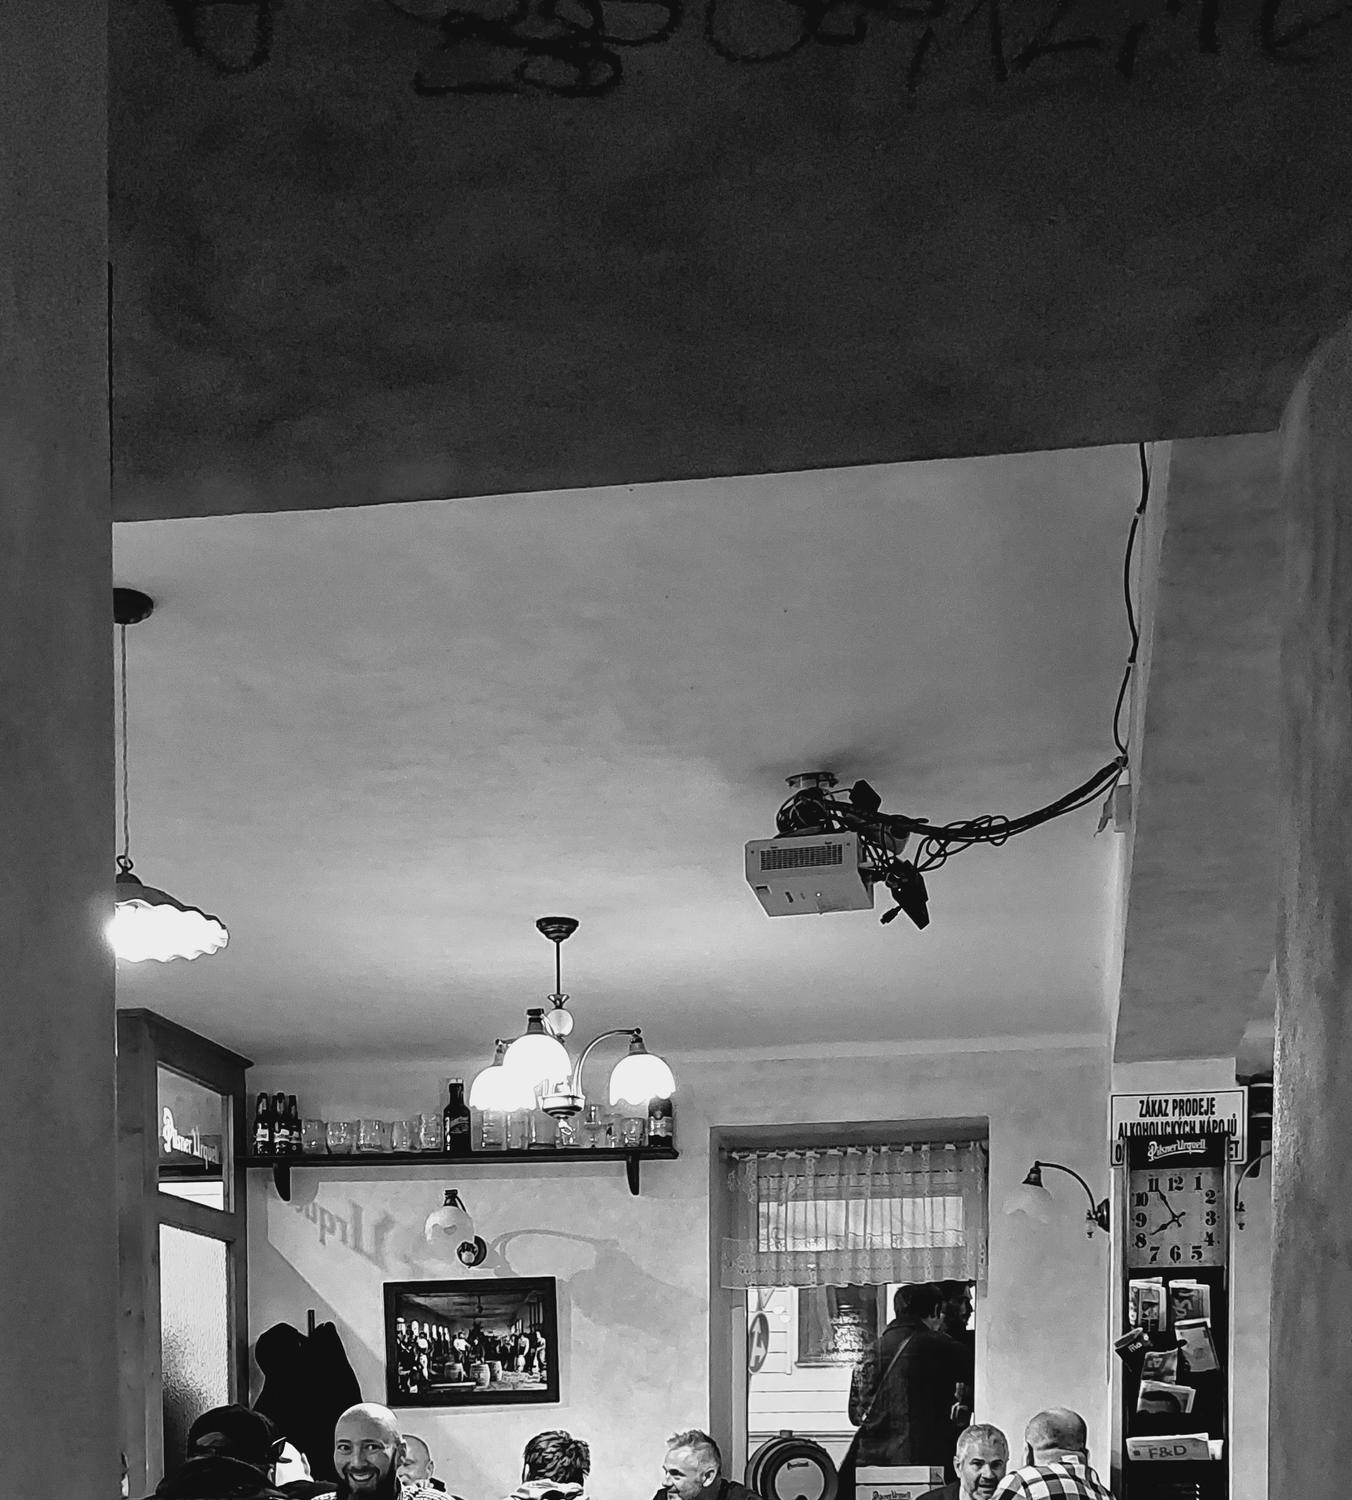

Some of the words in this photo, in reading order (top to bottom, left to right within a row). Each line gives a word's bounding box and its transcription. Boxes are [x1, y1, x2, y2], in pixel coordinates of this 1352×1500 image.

[1139, 1096, 1169, 1118] ZÁKAZ
[1172, 1097, 1216, 1117] PRODEJE
[1148, 1178, 1159, 1192] 11
[1168, 1176, 1184, 1191] 12
[1194, 1175, 1203, 1190] 1
[1135, 1192, 1148, 1207] 10
[1205, 1190, 1216, 1204] 2
[1135, 1212, 1147, 1228] 9
[1205, 1210, 1217, 1226] 3
[1135, 1233, 1147, 1248] 8
[1204, 1231, 1215, 1246] 4
[1149, 1246, 1160, 1264] 7
[1169, 1245, 1181, 1263] 6
[1191, 1245, 1203, 1260] 5
[1148, 1445, 1188, 1459] F&D
